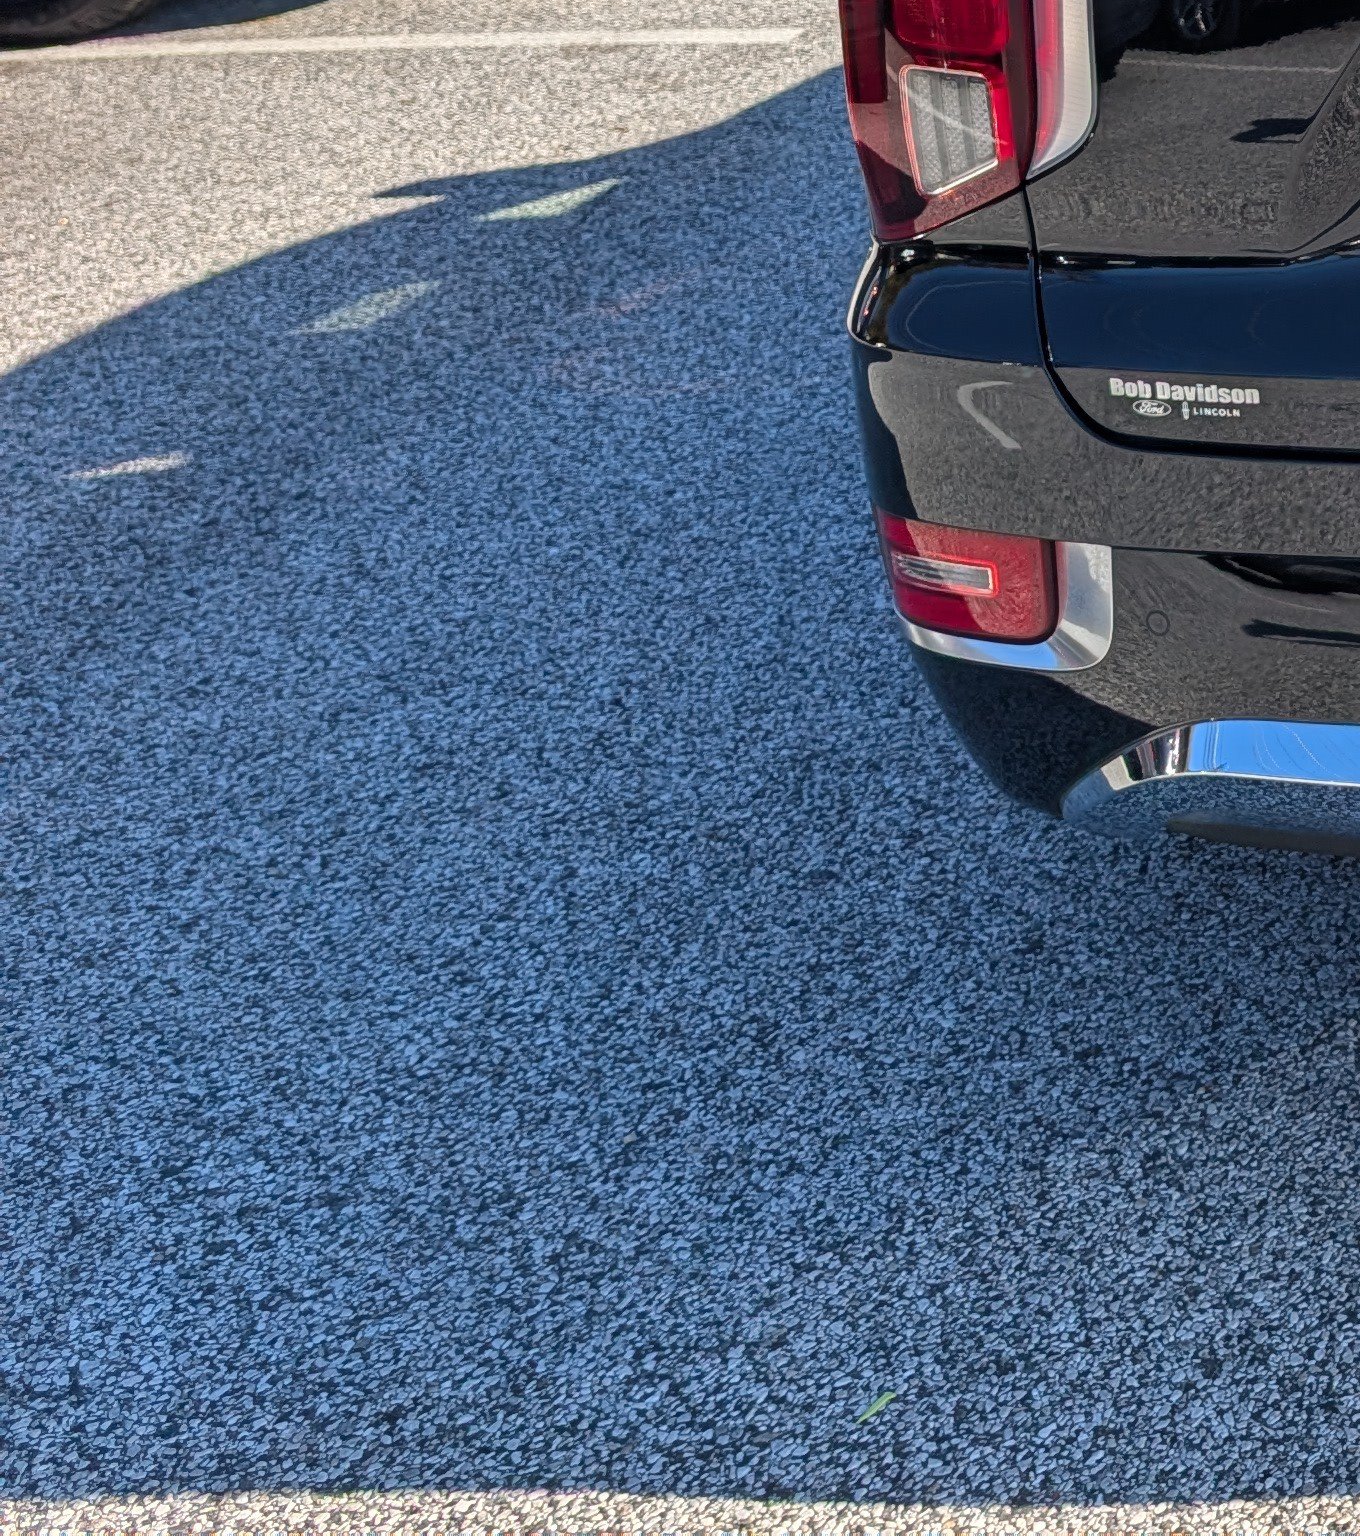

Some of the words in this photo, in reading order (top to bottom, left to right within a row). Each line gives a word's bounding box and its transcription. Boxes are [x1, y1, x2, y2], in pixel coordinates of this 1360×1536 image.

[1109, 378, 1152, 399] Bob
[1155, 381, 1261, 404] Davidson
[1193, 406, 1241, 418] LINCOLN
